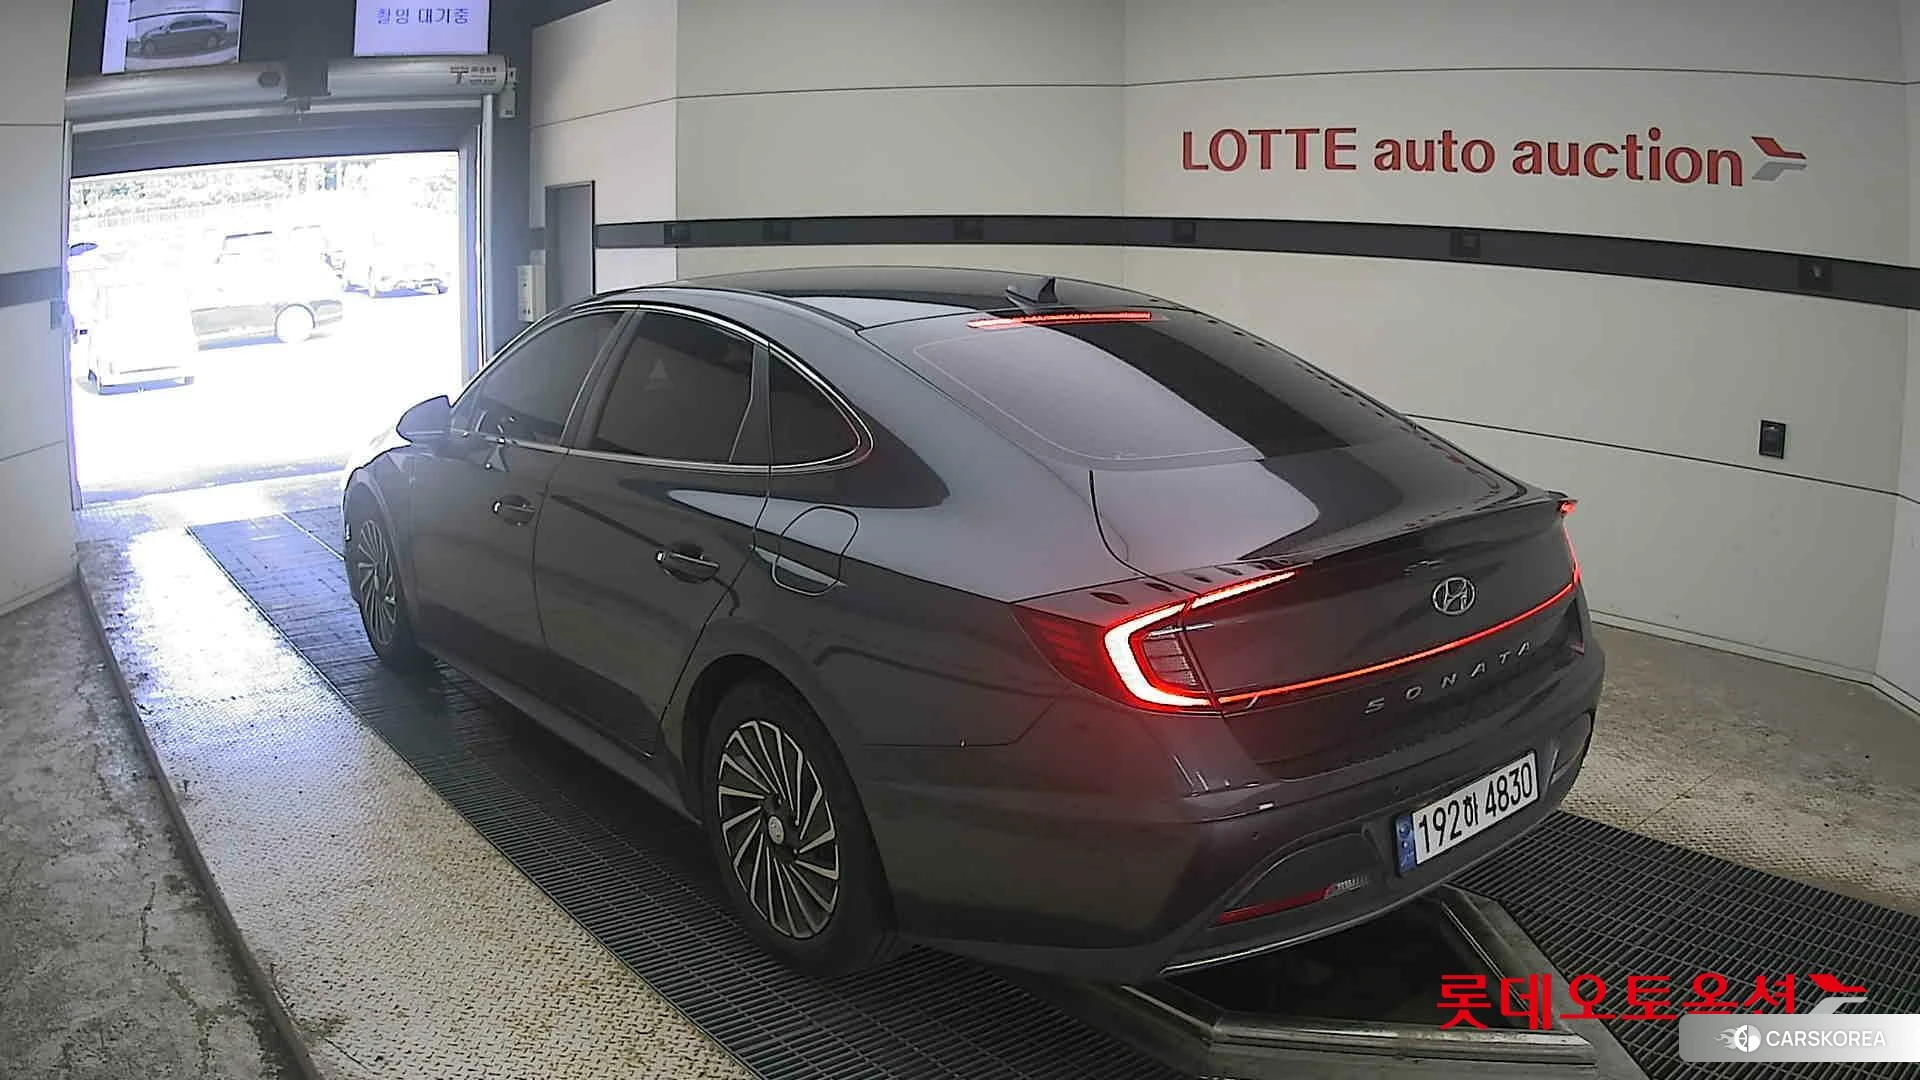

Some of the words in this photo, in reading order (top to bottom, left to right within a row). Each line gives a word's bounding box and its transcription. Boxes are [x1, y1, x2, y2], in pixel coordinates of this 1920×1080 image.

[418, 8, 470, 24] 대기중
[1183, 127, 1357, 171] LOTTE
[1374, 129, 1495, 173] auto
[1512, 127, 1744, 187] auction
[1363, 640, 1532, 715] SONATA
[1418, 791, 1479, 854] 192하
[1485, 762, 1533, 818] 4830
